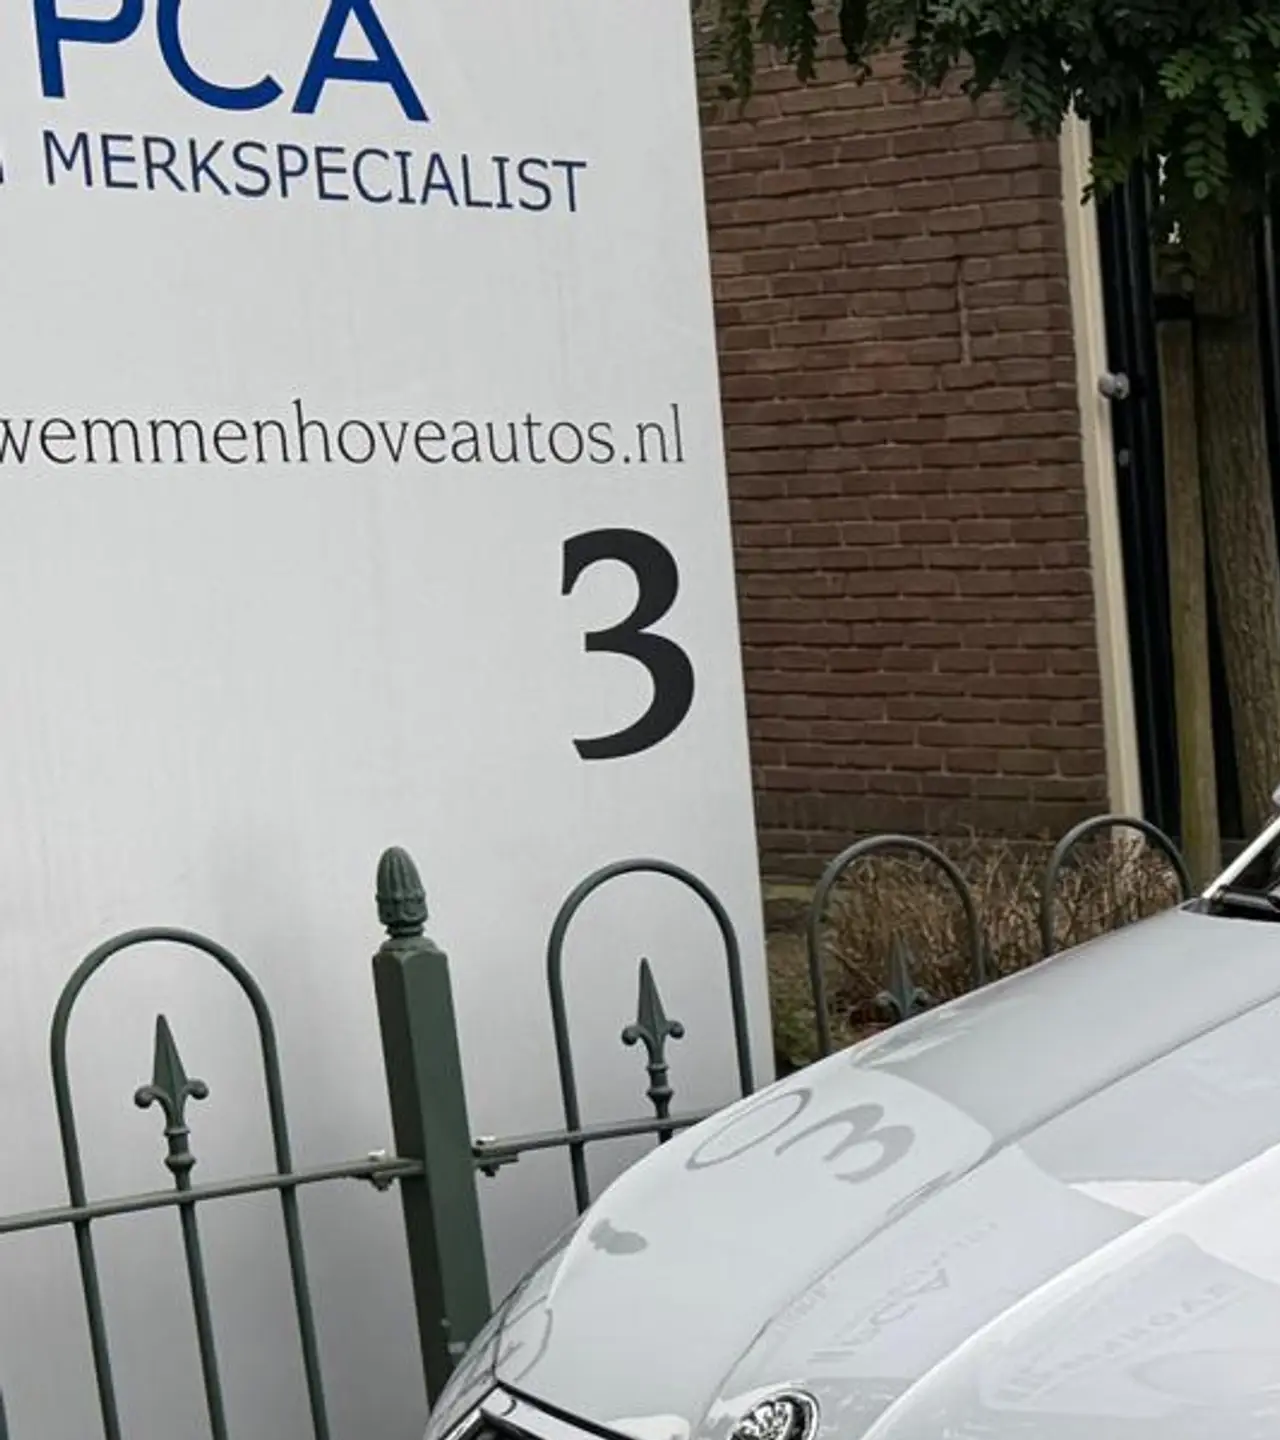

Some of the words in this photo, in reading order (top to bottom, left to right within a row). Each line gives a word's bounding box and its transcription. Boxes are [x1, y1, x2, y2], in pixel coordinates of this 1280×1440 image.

[33, 0, 429, 122] PCA
[42, 129, 587, 213] MERKSPECIALIST
[0, 398, 686, 464] wemmenhoveautos.nl
[561, 527, 695, 760] 3
